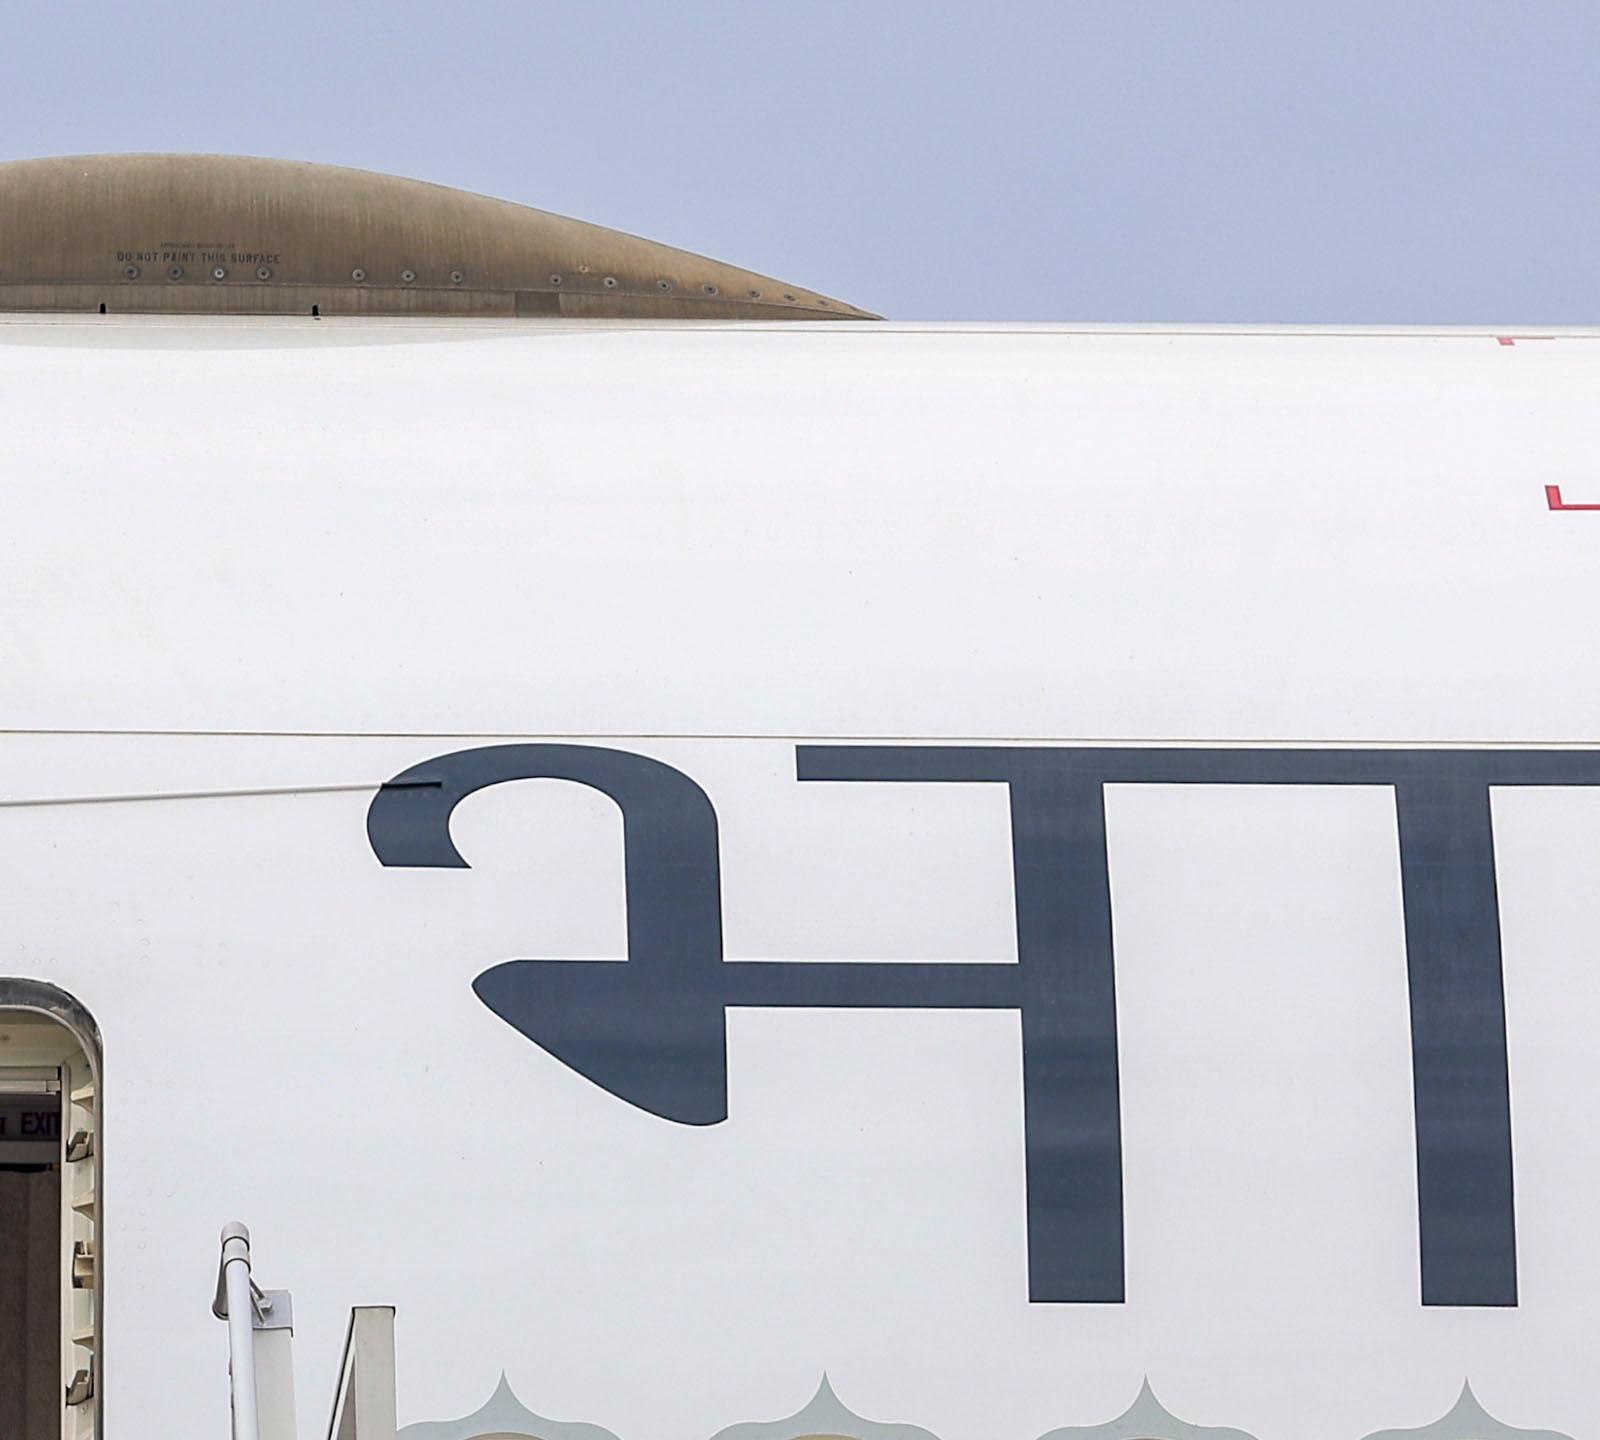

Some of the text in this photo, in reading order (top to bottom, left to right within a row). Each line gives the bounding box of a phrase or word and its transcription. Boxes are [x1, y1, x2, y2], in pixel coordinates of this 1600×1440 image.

[116, 252, 281, 264] DO NOT PAINT THIS SURFACE
